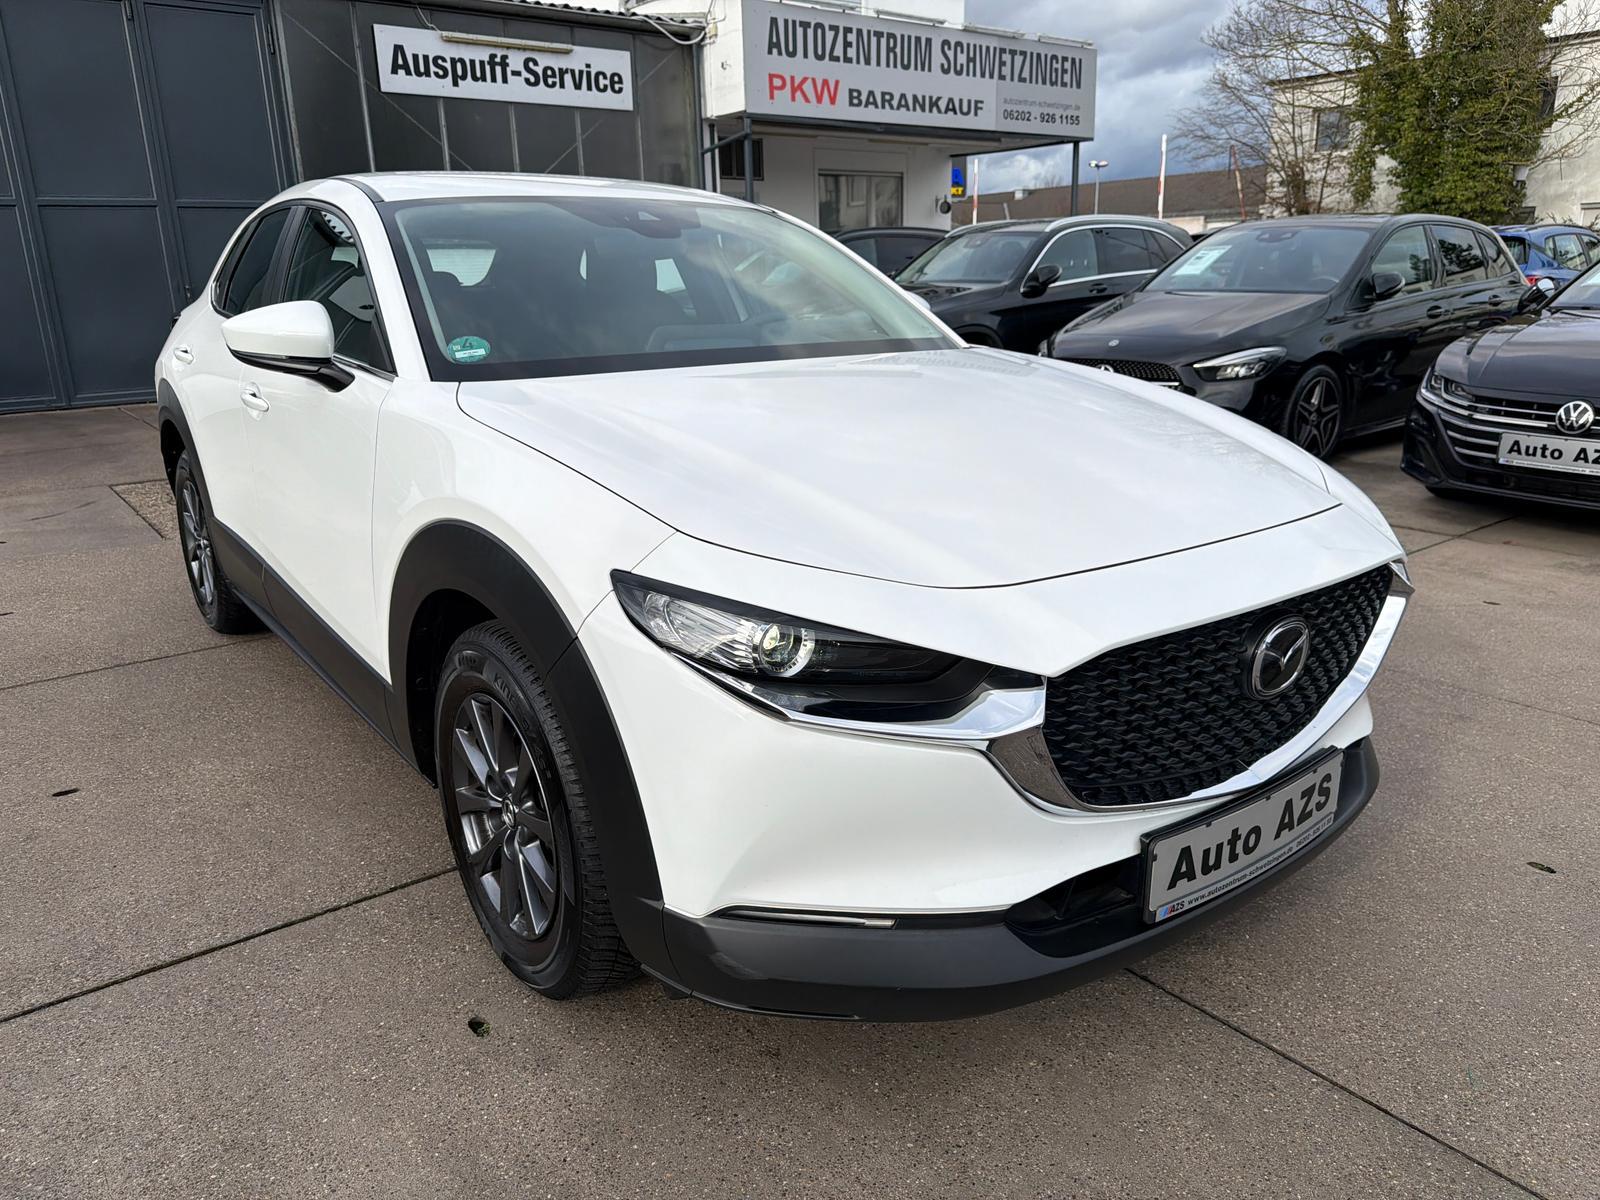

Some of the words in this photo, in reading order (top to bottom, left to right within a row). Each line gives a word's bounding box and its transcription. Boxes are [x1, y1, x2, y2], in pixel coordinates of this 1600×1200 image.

[390, 43, 625, 95] Auspuff-Service
[767, 16, 932, 73] AUTOZENTRUM
[940, 39, 1082, 90] SCHWETZINGEN
[767, 72, 840, 106] PKW
[848, 88, 984, 118] BARANKAUF
[1003, 109, 1032, 122] 06202
[1039, 112, 1057, 124] 926
[1059, 114, 1081, 126] 1155
[1507, 439, 1564, 460] Auto
[1167, 824, 1262, 891] Auto
[1273, 772, 1333, 841] AZS
